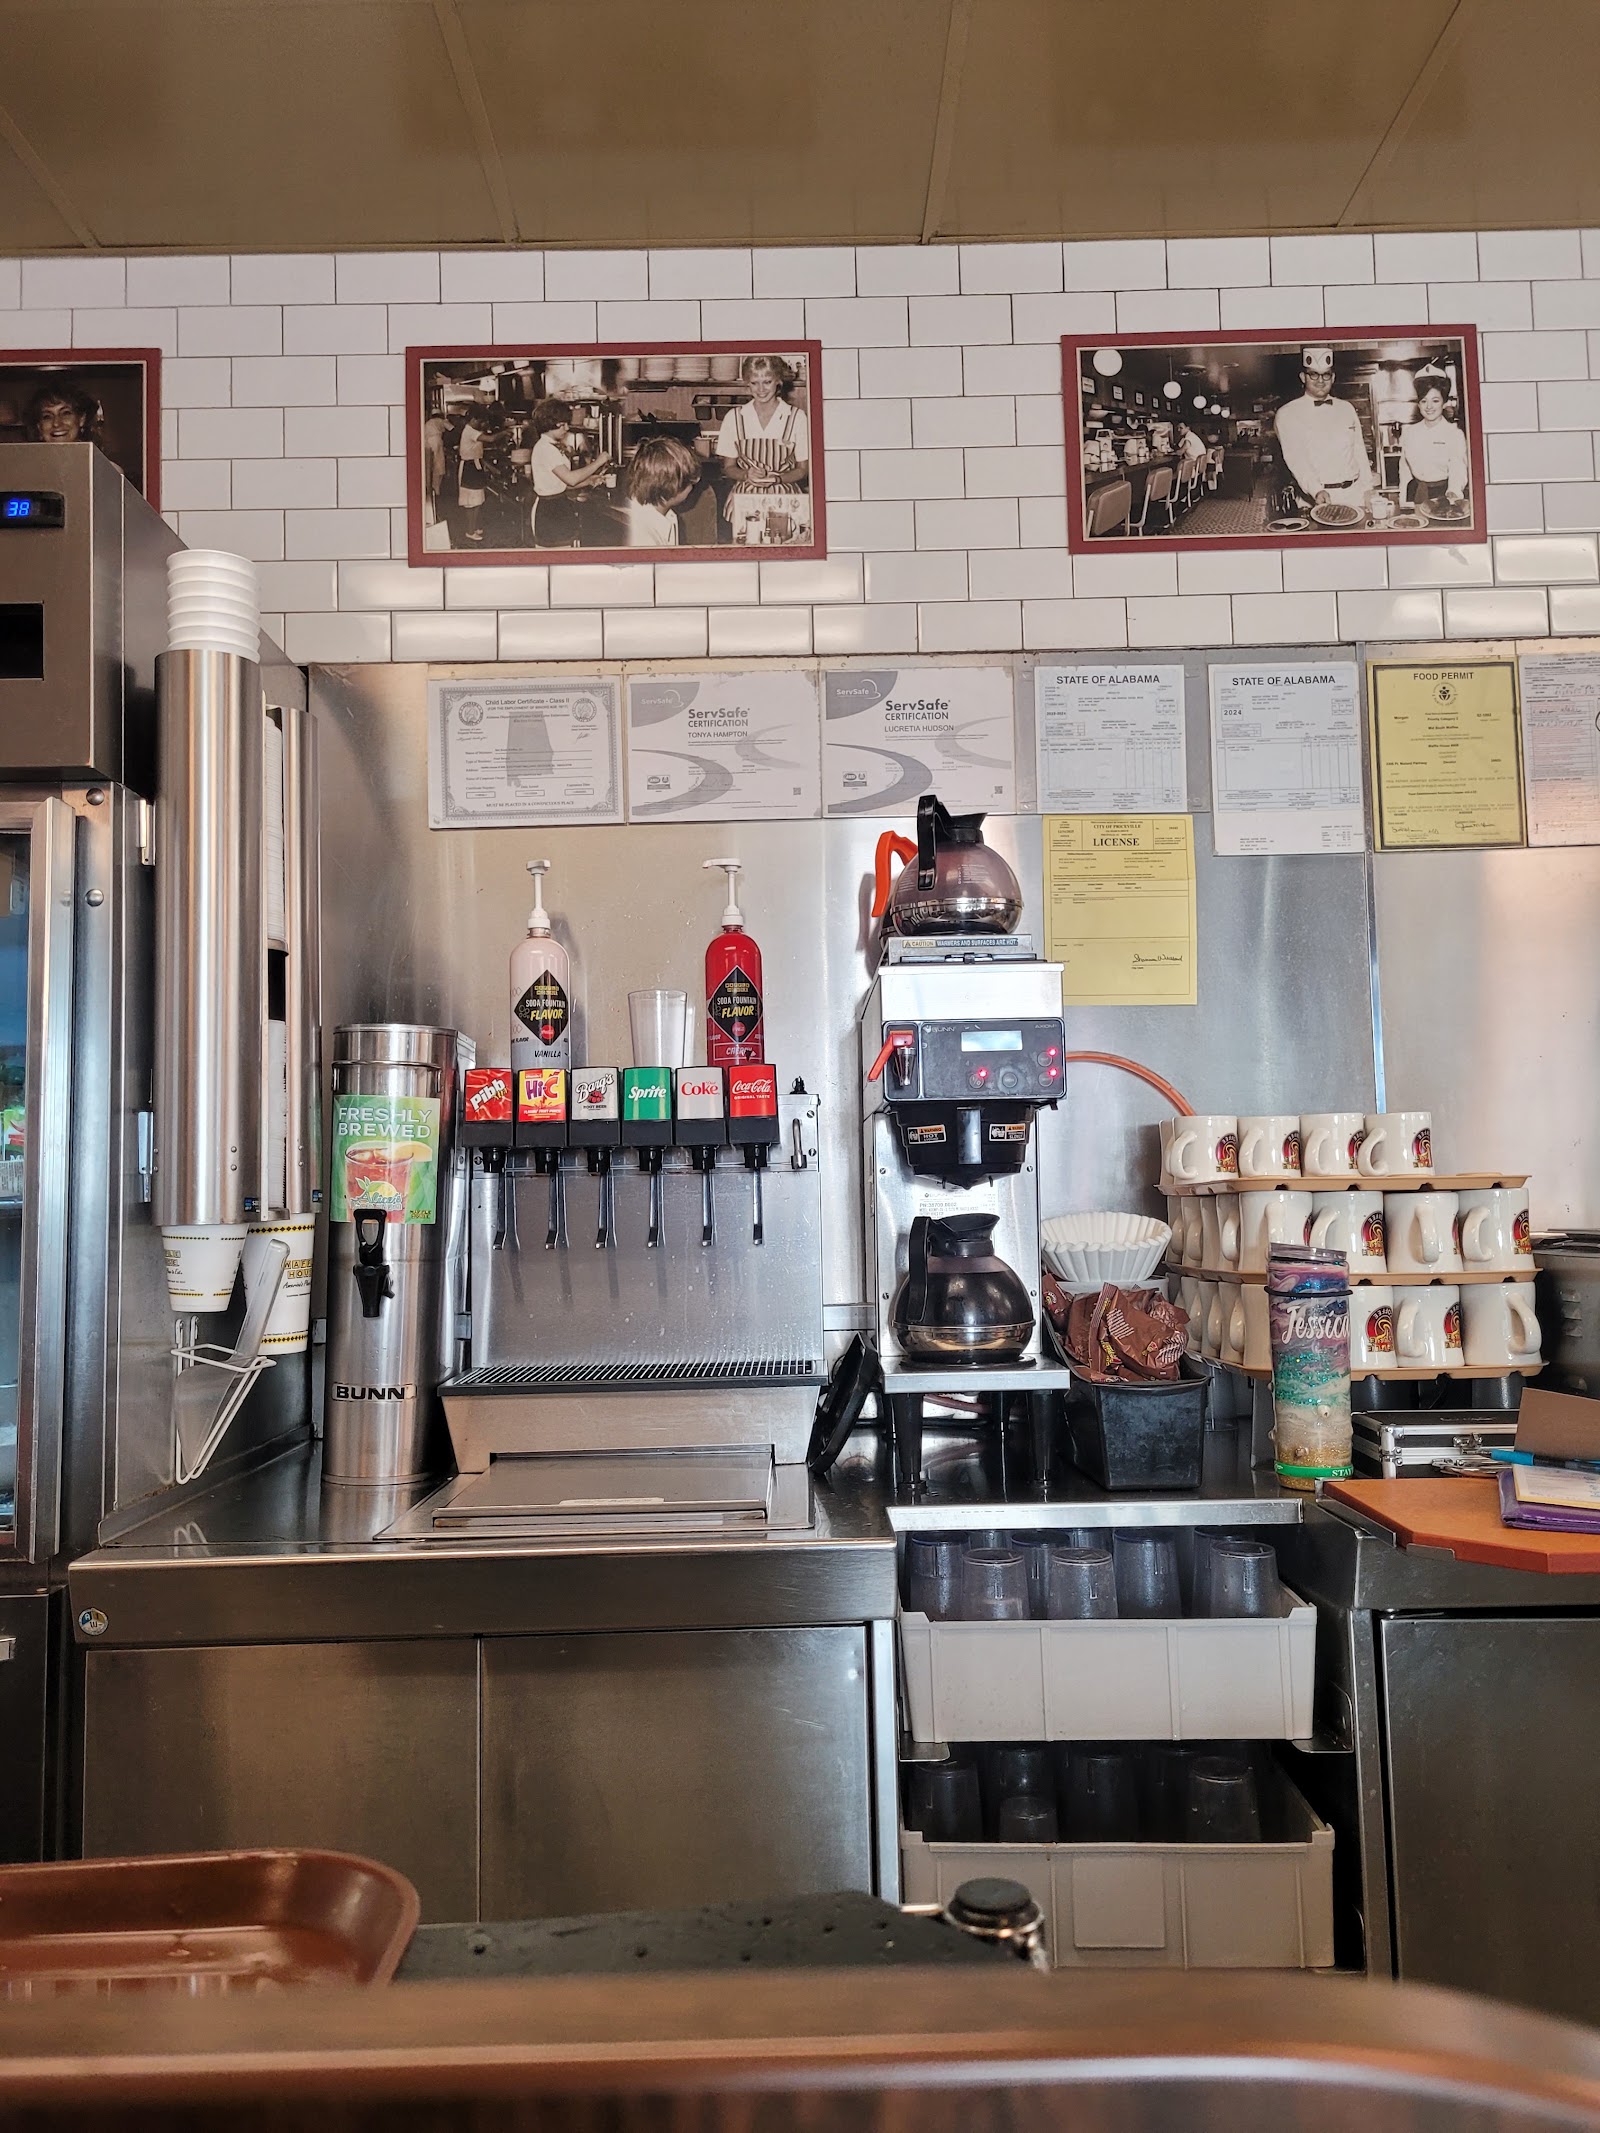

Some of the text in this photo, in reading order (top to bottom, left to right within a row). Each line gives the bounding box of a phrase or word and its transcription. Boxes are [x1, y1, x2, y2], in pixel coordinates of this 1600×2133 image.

[8, 501, 30, 517] 38
[1057, 675, 1160, 684] STATE OF ALABAMA
[1232, 675, 1335, 686] STATE OF ALABAMA
[1441, 672, 1474, 680] PERMIT
[885, 699, 948, 711] ServSafe
[688, 707, 748, 719] ServSafe
[885, 712, 948, 720] CERTIFICATION
[688, 720, 748, 728] CERTIFICATION
[1093, 838, 1140, 847] LICENSE
[542, 1000, 566, 1009] FOUNTAIN
[530, 1009, 563, 1021] FLAVOR
[722, 1005, 754, 1018] FLAVOR
[525, 1076, 559, 1100] Hi-C
[576, 1074, 614, 1103] Barq's
[628, 1085, 666, 1100] Sprite
[681, 1082, 718, 1095] Coke
[732, 1079, 772, 1094] Coca-Cola
[470, 1079, 505, 1111] Pibb
[339, 1107, 432, 1123] FRESHLY
[338, 1123, 431, 1138] BREWED
[283, 1260, 313, 1269] WAFF
[287, 1270, 312, 1279] HOU
[1373, 1308, 1392, 1318] OFFEE
[336, 1386, 405, 1400] BUNN
